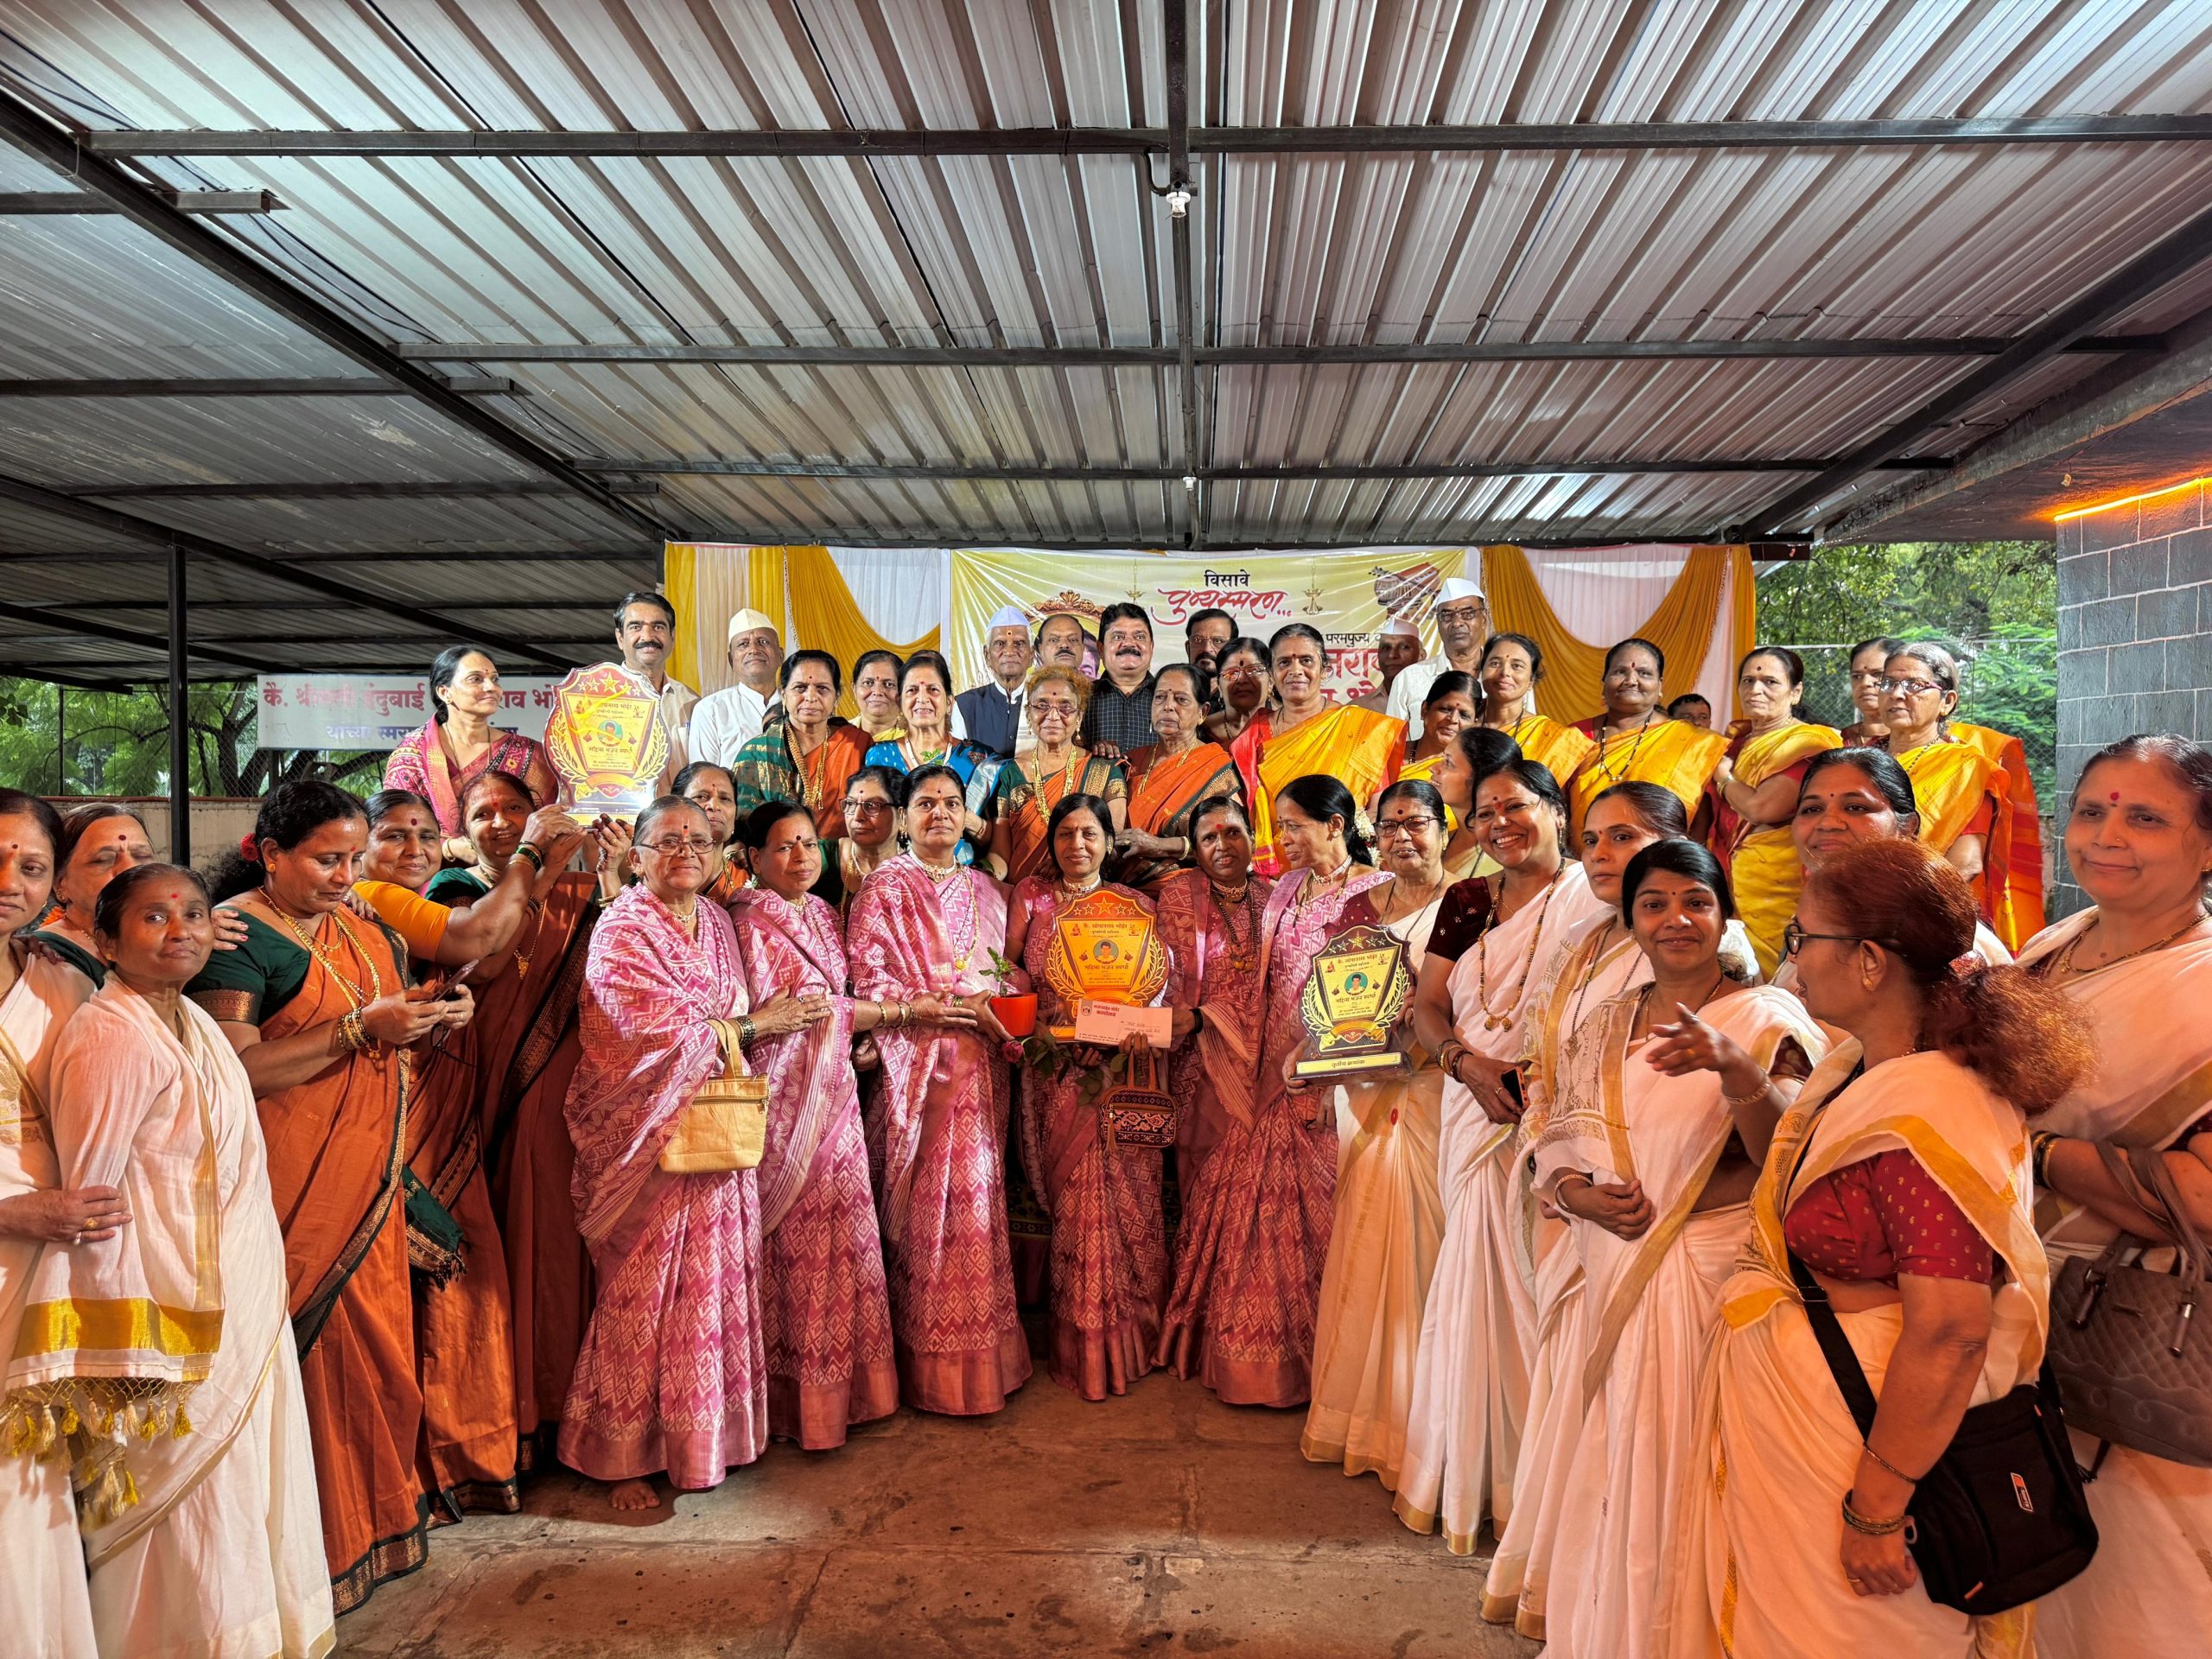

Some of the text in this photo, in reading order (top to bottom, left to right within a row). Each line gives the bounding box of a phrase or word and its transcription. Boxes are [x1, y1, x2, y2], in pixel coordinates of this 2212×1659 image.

[1204, 569, 1250, 588] विसावे
[1325, 632, 1370, 647] परमपुज्य
[361, 683, 425, 716] इंदुबाई
